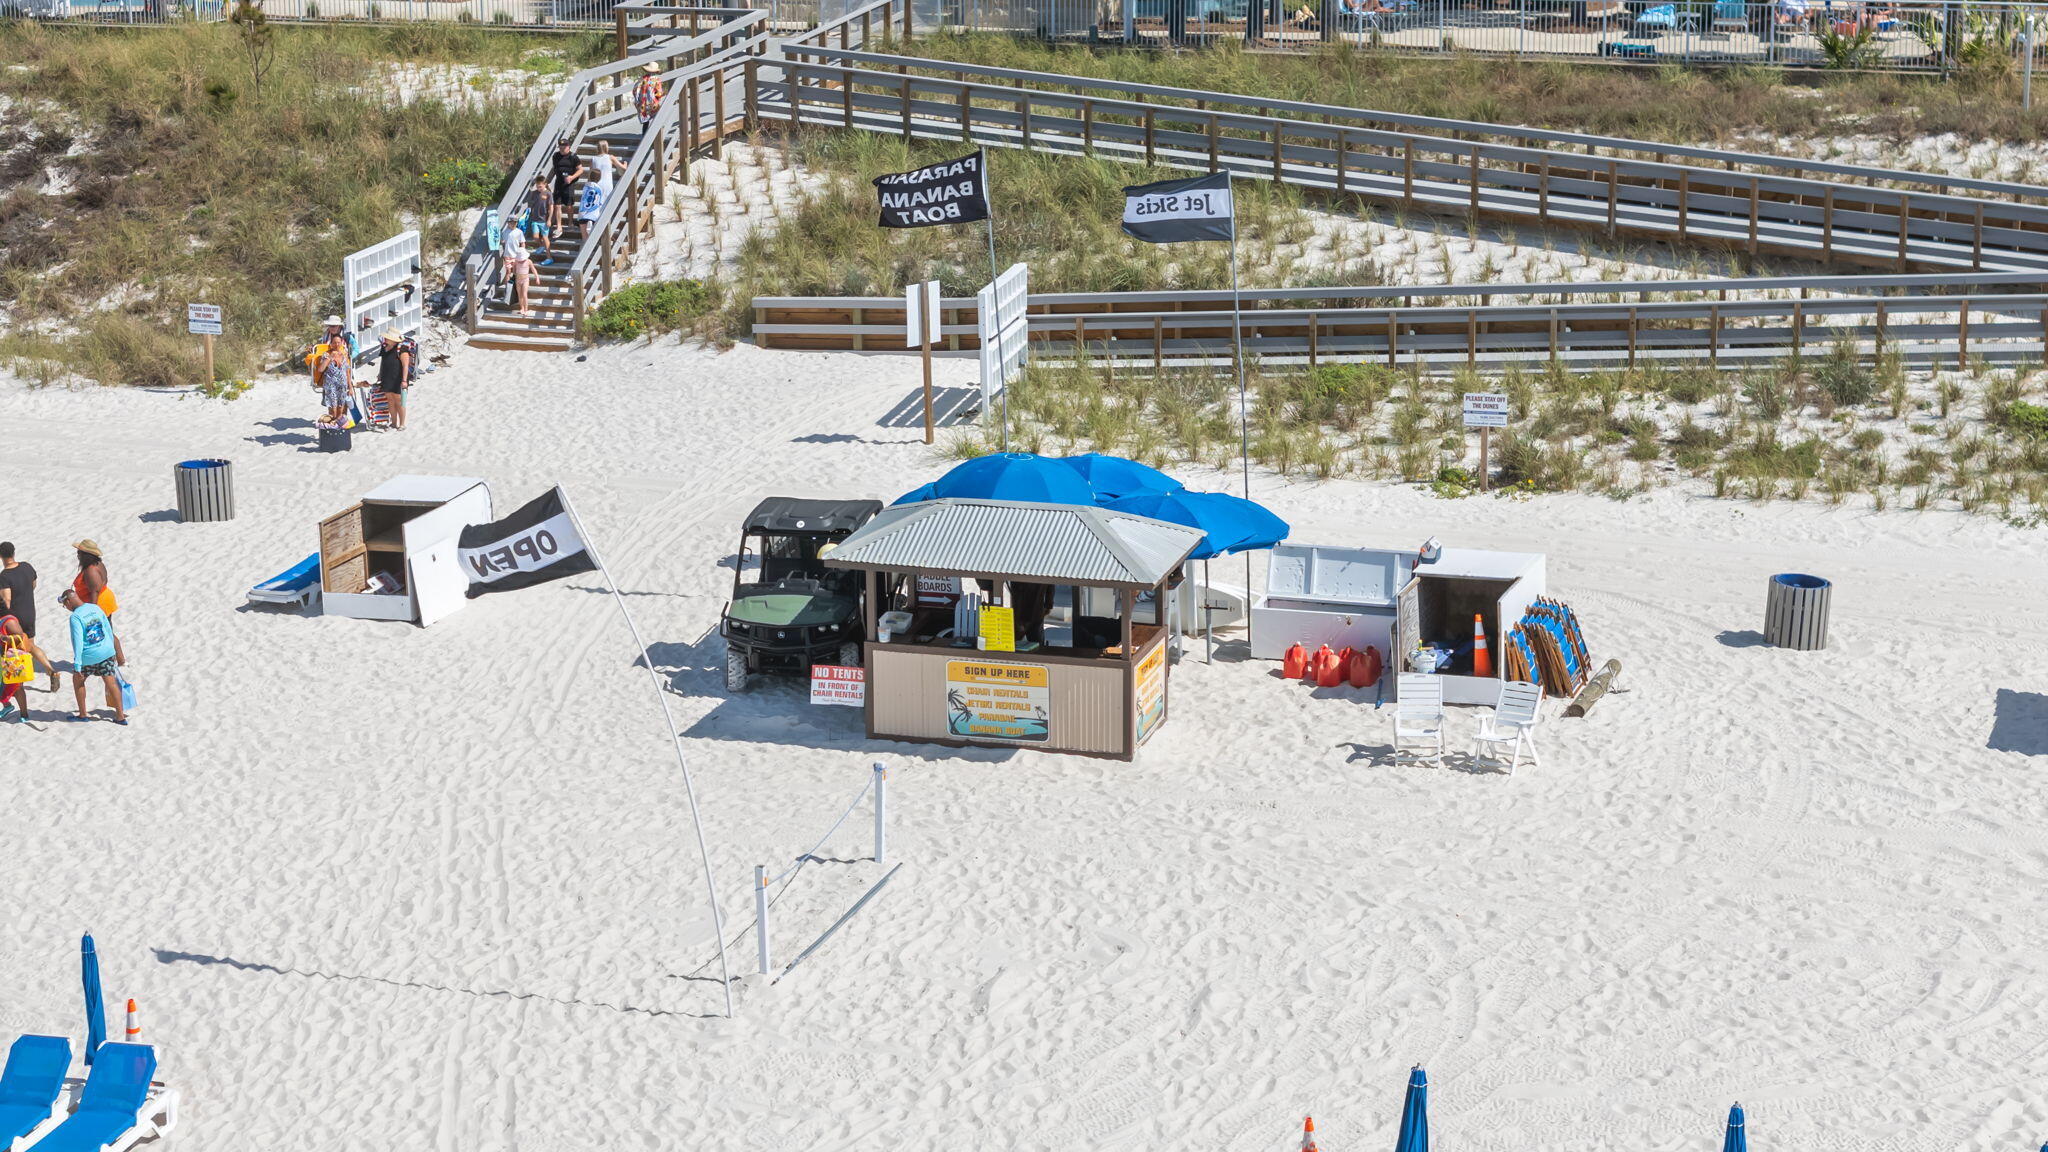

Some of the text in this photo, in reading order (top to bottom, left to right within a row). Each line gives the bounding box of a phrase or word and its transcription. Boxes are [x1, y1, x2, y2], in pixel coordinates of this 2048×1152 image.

[918, 582, 952, 592] BOARDS
[814, 667, 864, 680] NO TENTS
[964, 666, 1030, 678] SIGN UP HERE
[834, 691, 863, 700] RENTALS
